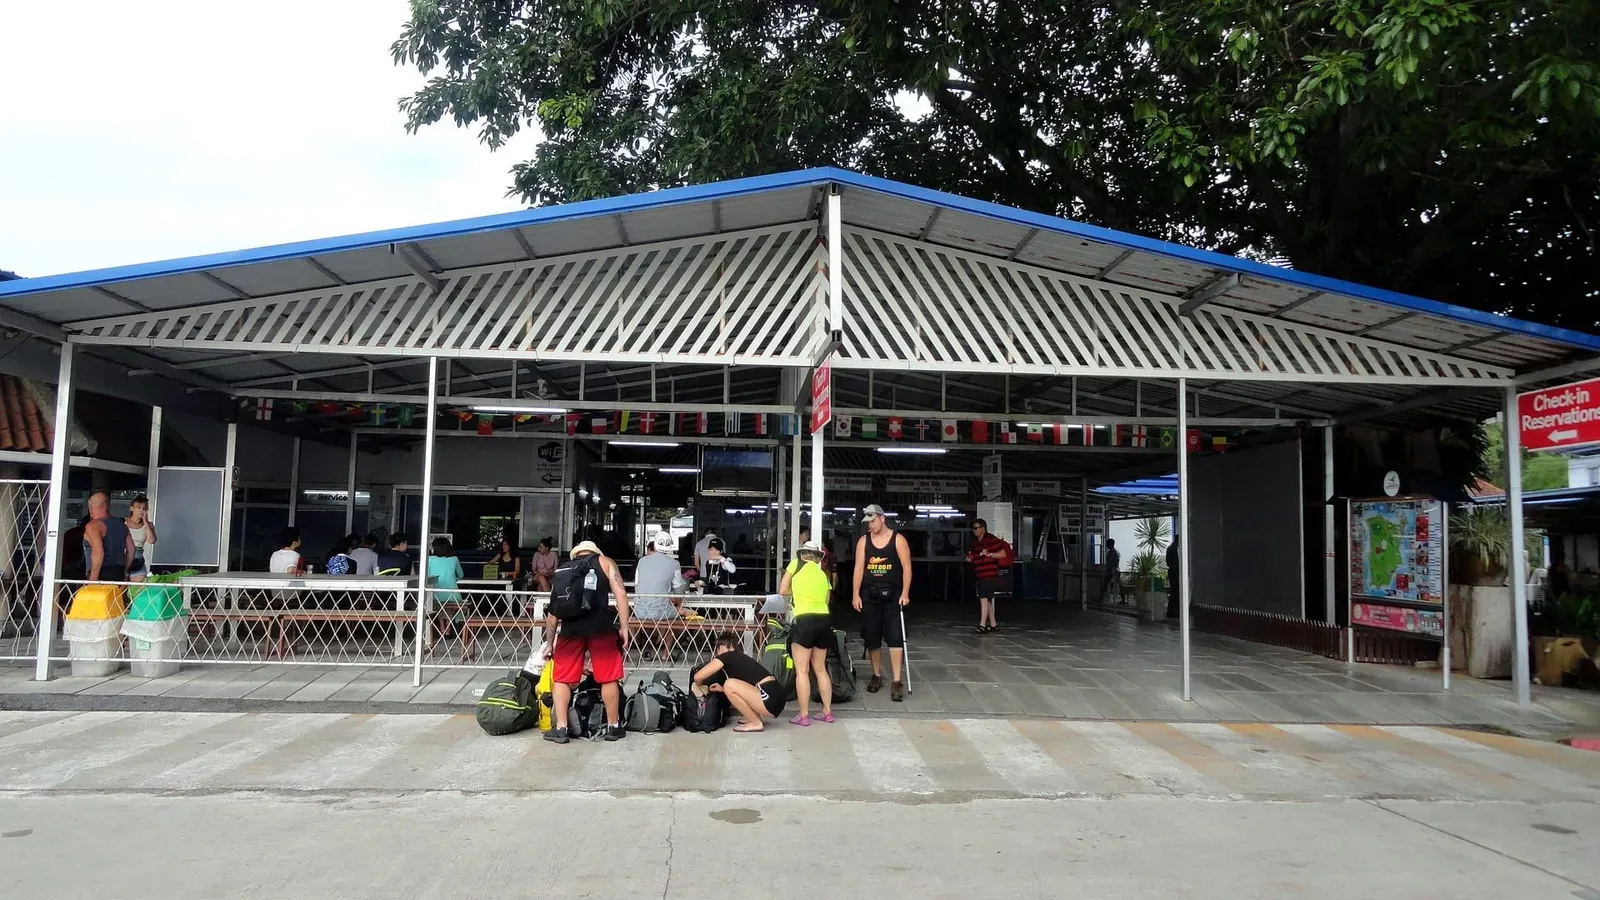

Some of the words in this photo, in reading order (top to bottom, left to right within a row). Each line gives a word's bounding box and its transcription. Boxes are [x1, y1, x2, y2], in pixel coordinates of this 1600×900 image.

[1533, 387, 1590, 411] Check-in
[1522, 406, 1600, 431] Reservations
[318, 494, 348, 502] Service
